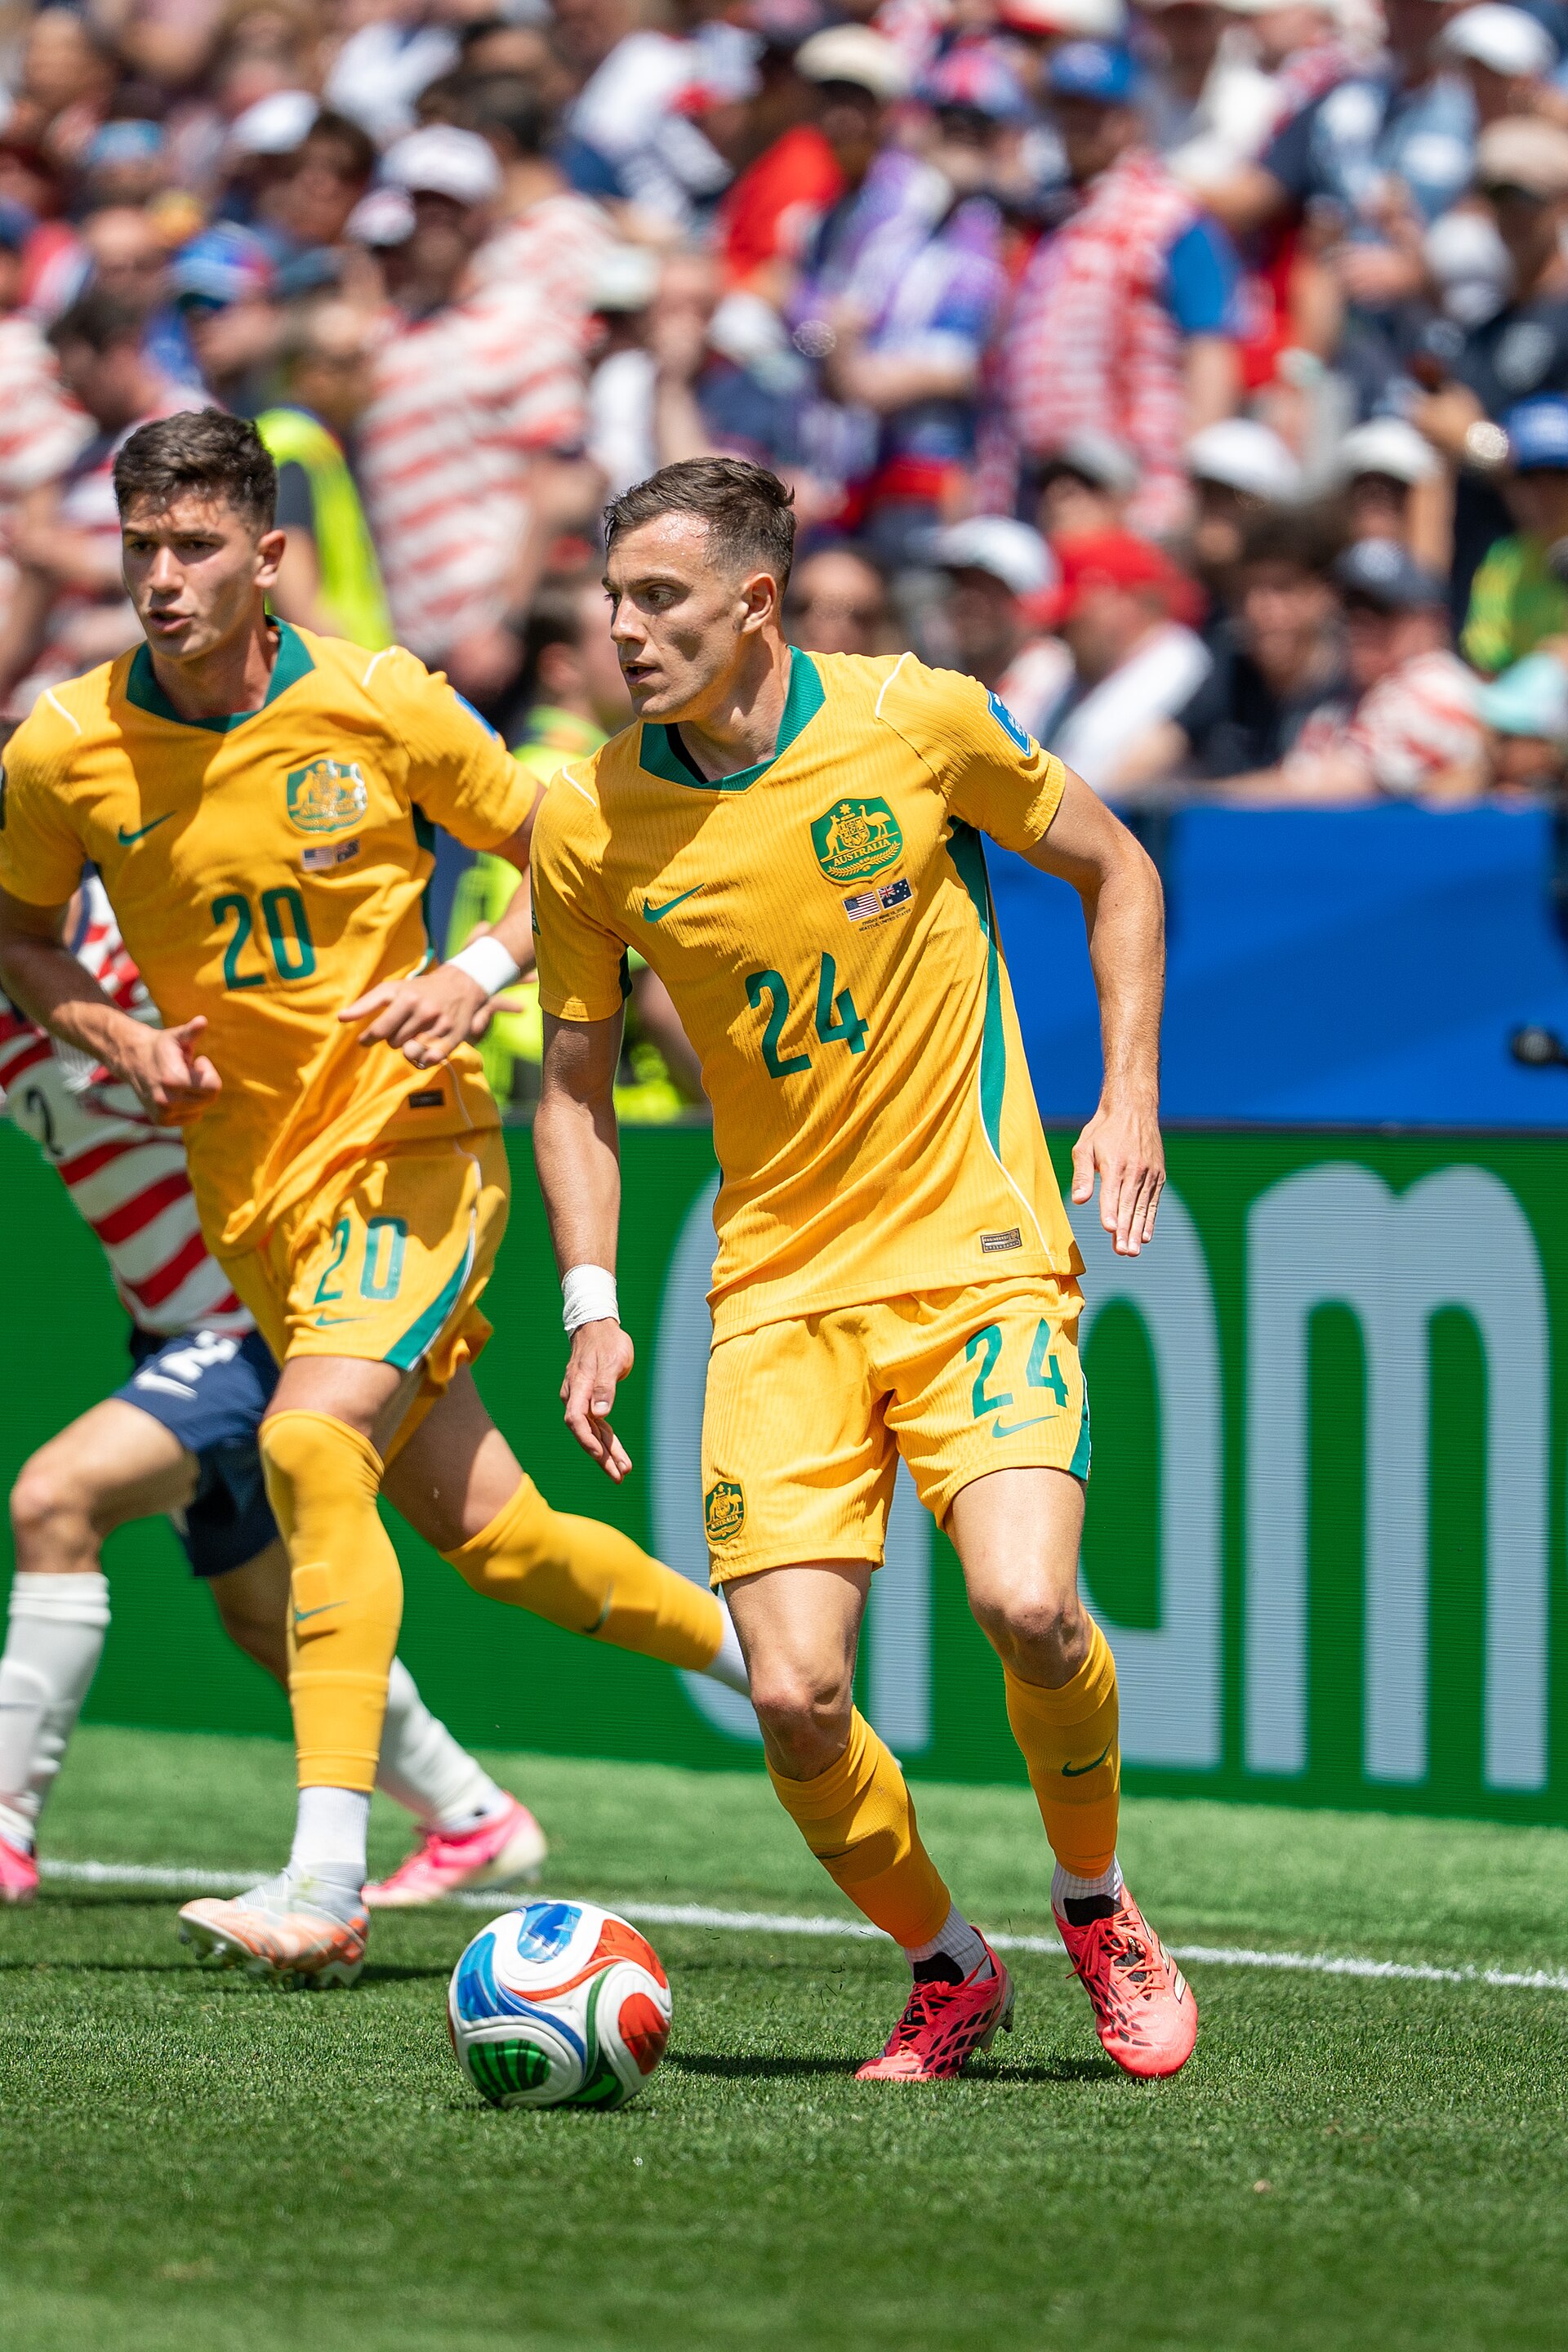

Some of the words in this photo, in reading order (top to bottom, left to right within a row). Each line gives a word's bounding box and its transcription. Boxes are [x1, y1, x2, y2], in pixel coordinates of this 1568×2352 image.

[834, 839, 892, 866] AUSTRALIA
[212, 886, 316, 991] 20
[745, 951, 870, 1079] 24
[314, 1216, 408, 1304] 20
[965, 1317, 1069, 1419] 24
